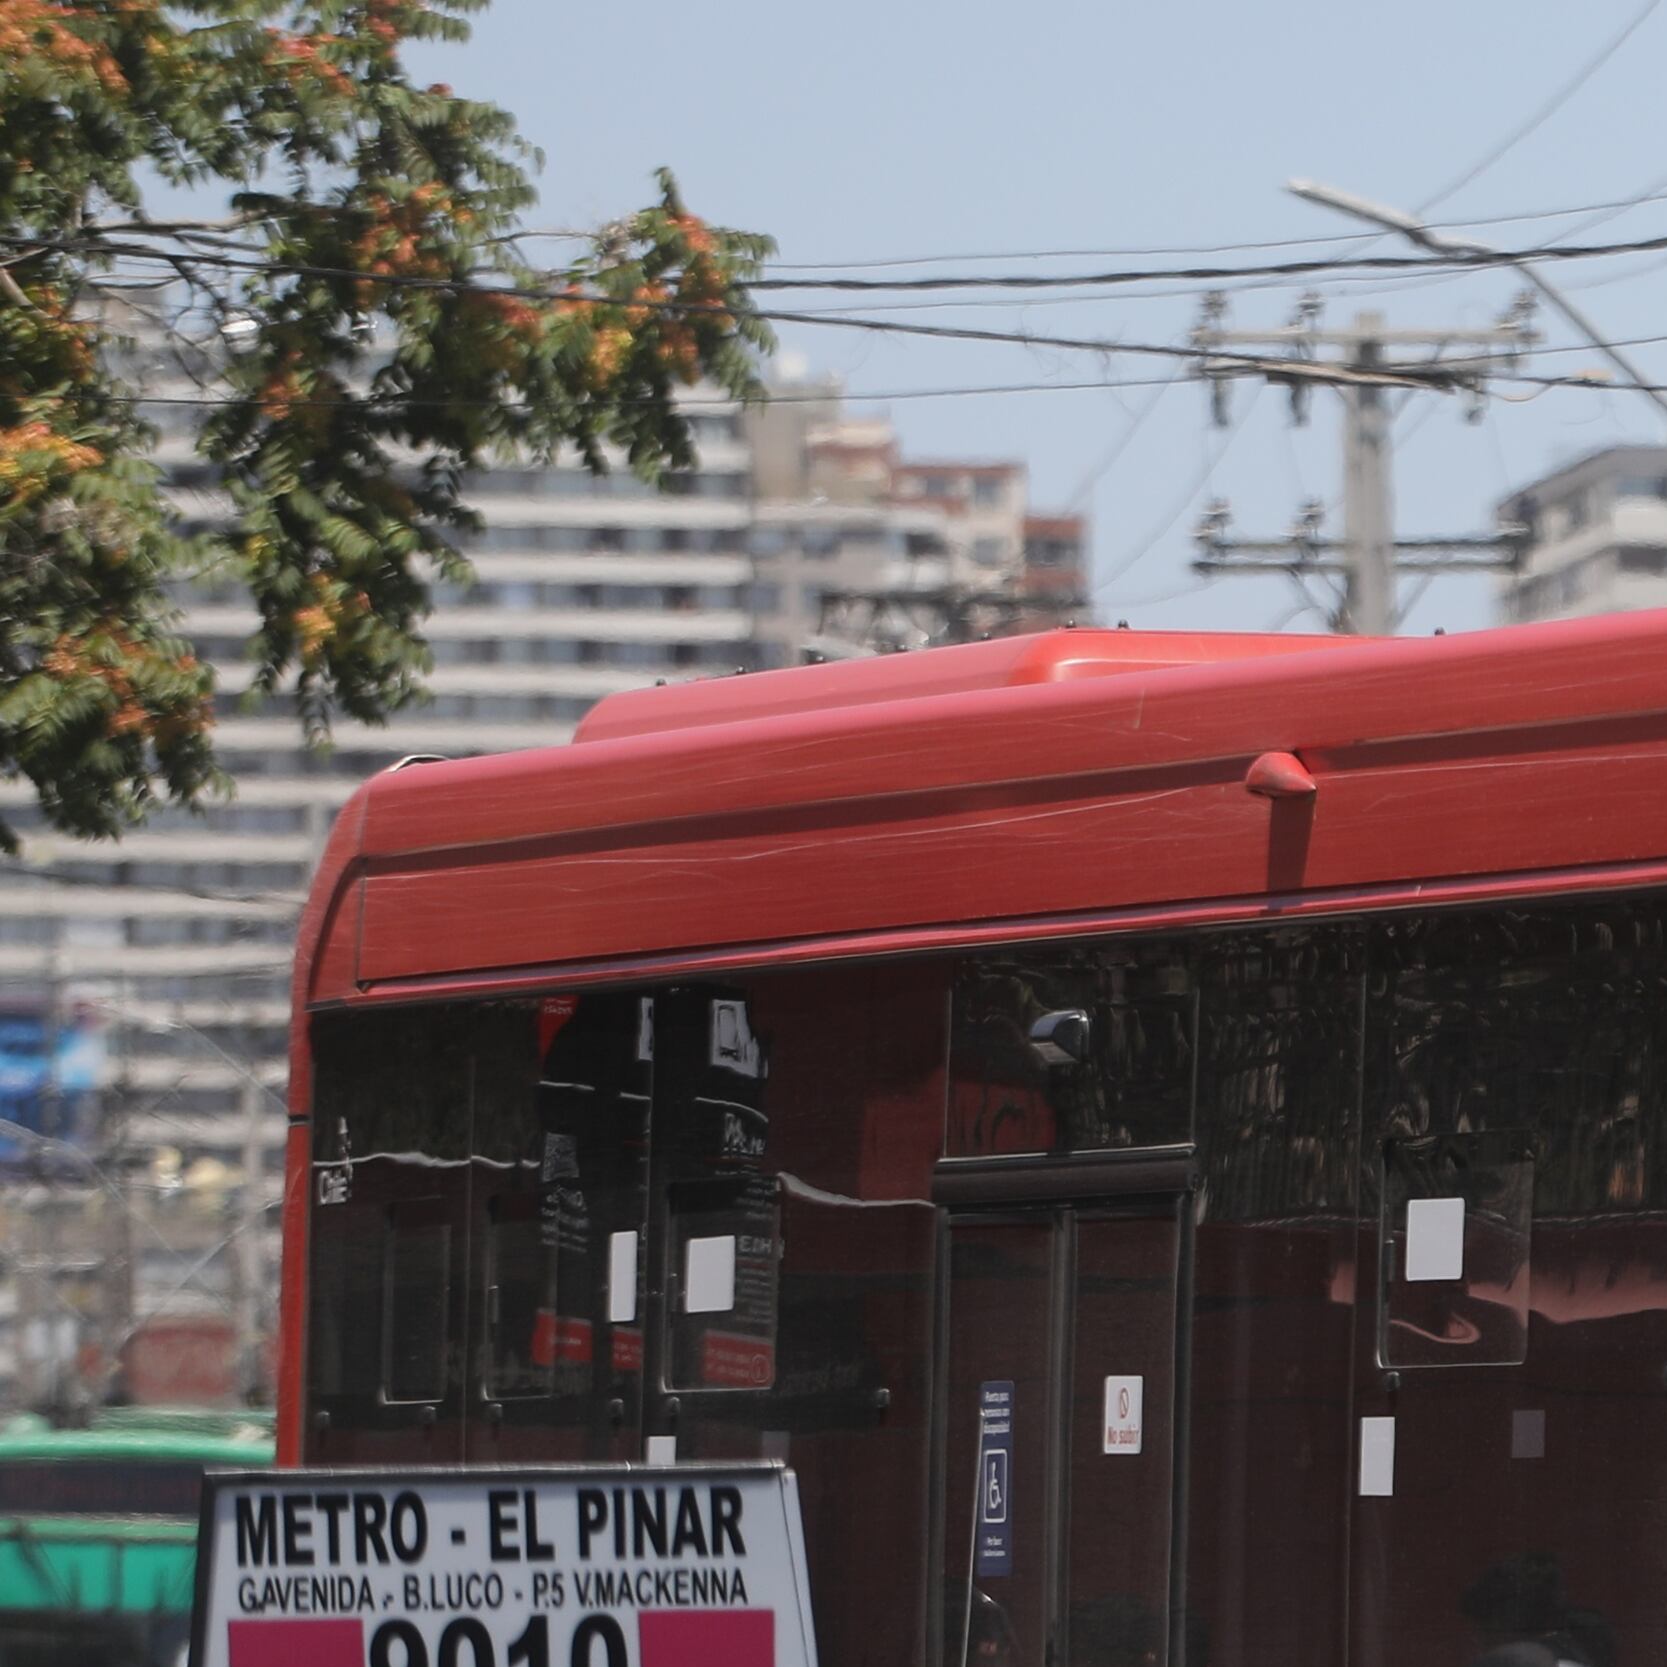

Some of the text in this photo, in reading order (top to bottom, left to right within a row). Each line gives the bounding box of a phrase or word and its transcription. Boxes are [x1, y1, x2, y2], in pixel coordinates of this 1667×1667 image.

[235, 1490, 428, 1567] METRO
[488, 1489, 555, 1561] EL
[576, 1485, 748, 1560] PINAR
[403, 1572, 504, 1612] B.LUCO
[573, 1567, 750, 1608] V.MACKENNA
